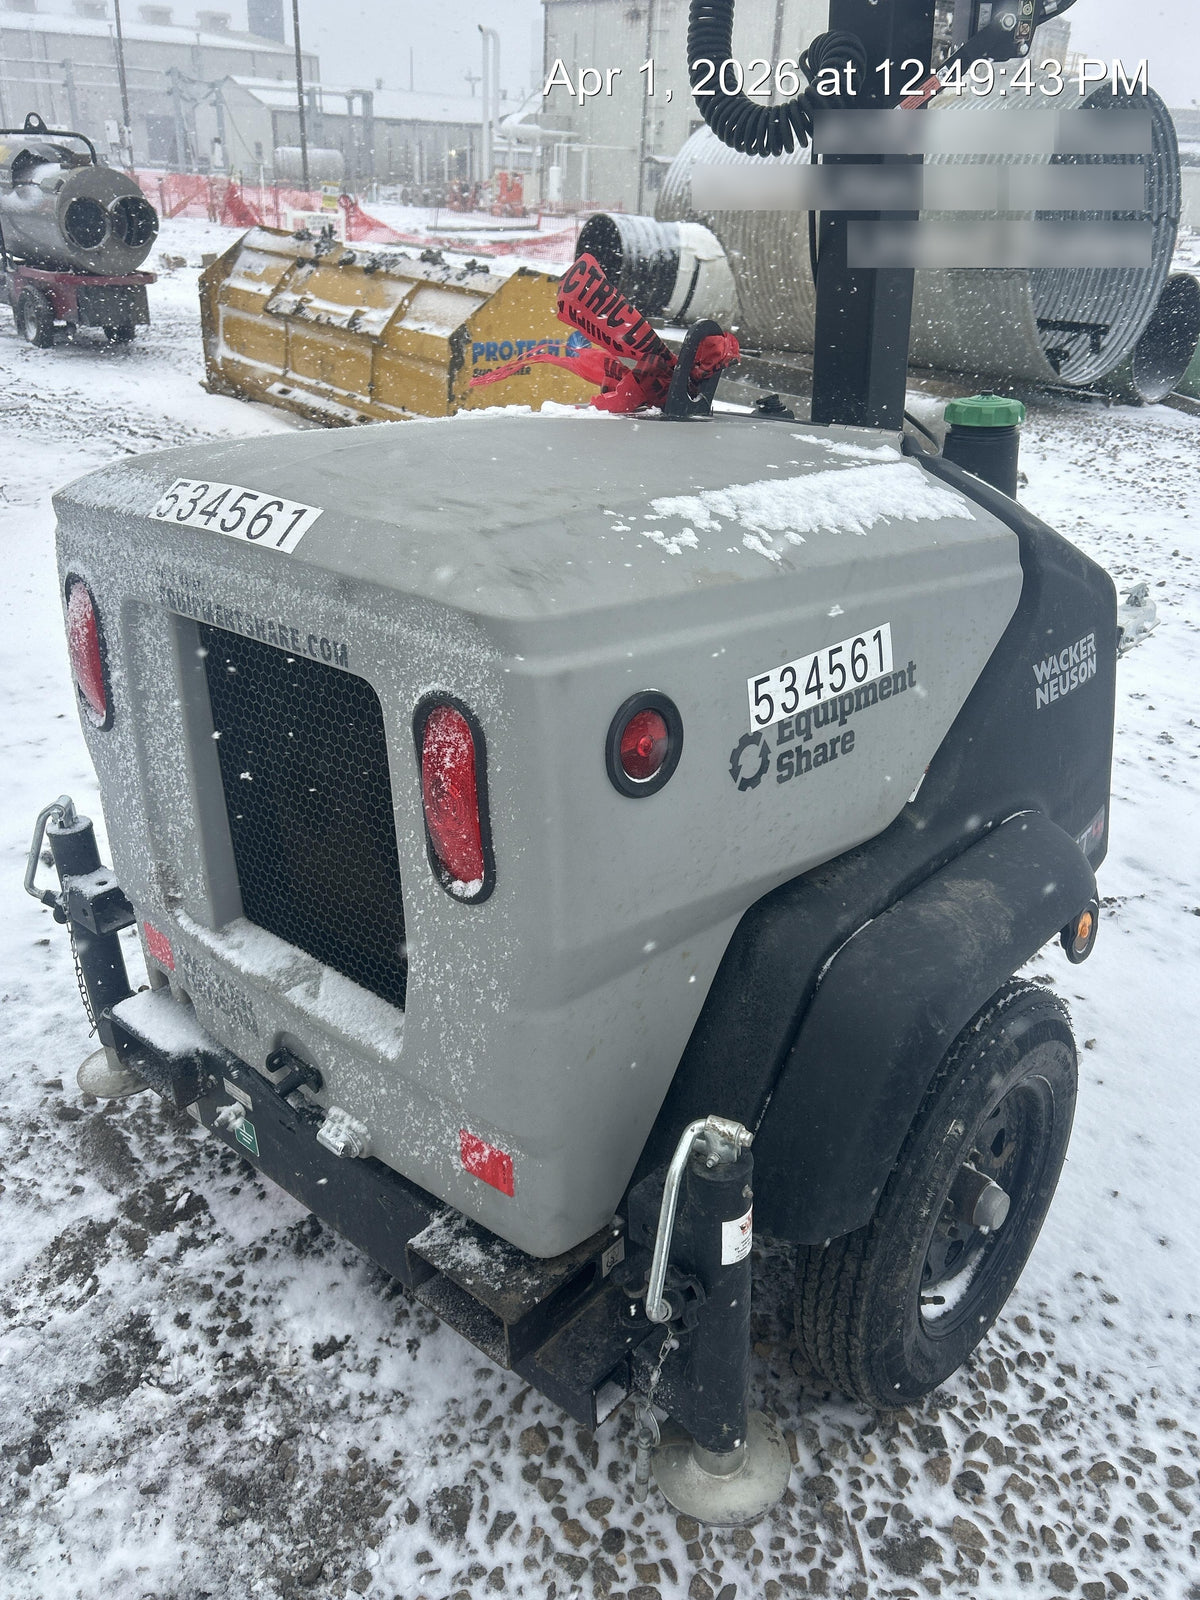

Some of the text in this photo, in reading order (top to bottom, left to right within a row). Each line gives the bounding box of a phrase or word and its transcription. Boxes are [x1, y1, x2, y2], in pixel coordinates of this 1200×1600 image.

[557, 259, 634, 329] CTRIC
[156, 481, 308, 548] 534561
[754, 629, 884, 725] 534561
[1032, 632, 1097, 685] WACKER
[1035, 653, 1097, 710] NEUSON
[776, 660, 917, 746] Equipment
[776, 729, 855, 785] Share
